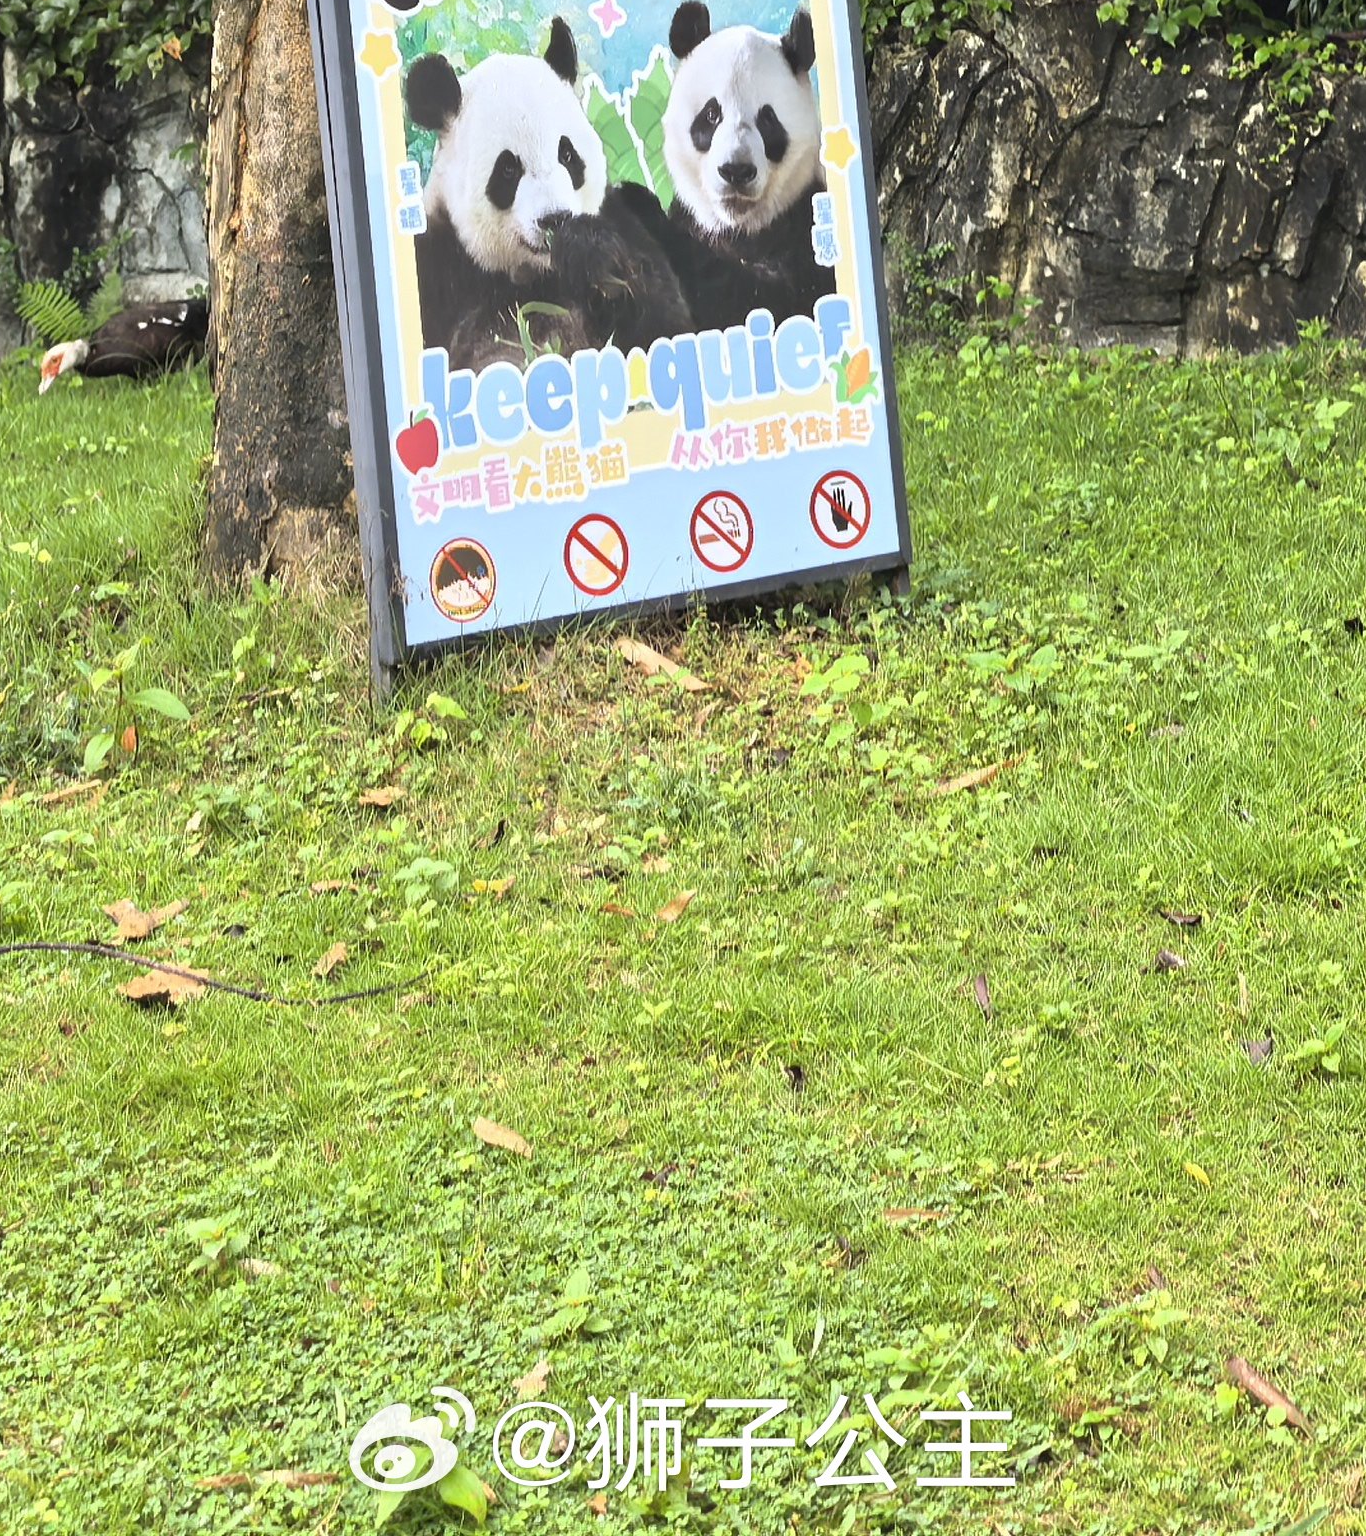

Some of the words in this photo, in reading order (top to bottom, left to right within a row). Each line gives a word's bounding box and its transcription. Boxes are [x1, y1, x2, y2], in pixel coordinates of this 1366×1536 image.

[421, 351, 627, 450] keep
[670, 407, 871, 466] 从你我做起
[411, 443, 626, 519] 文明看大熊猫
